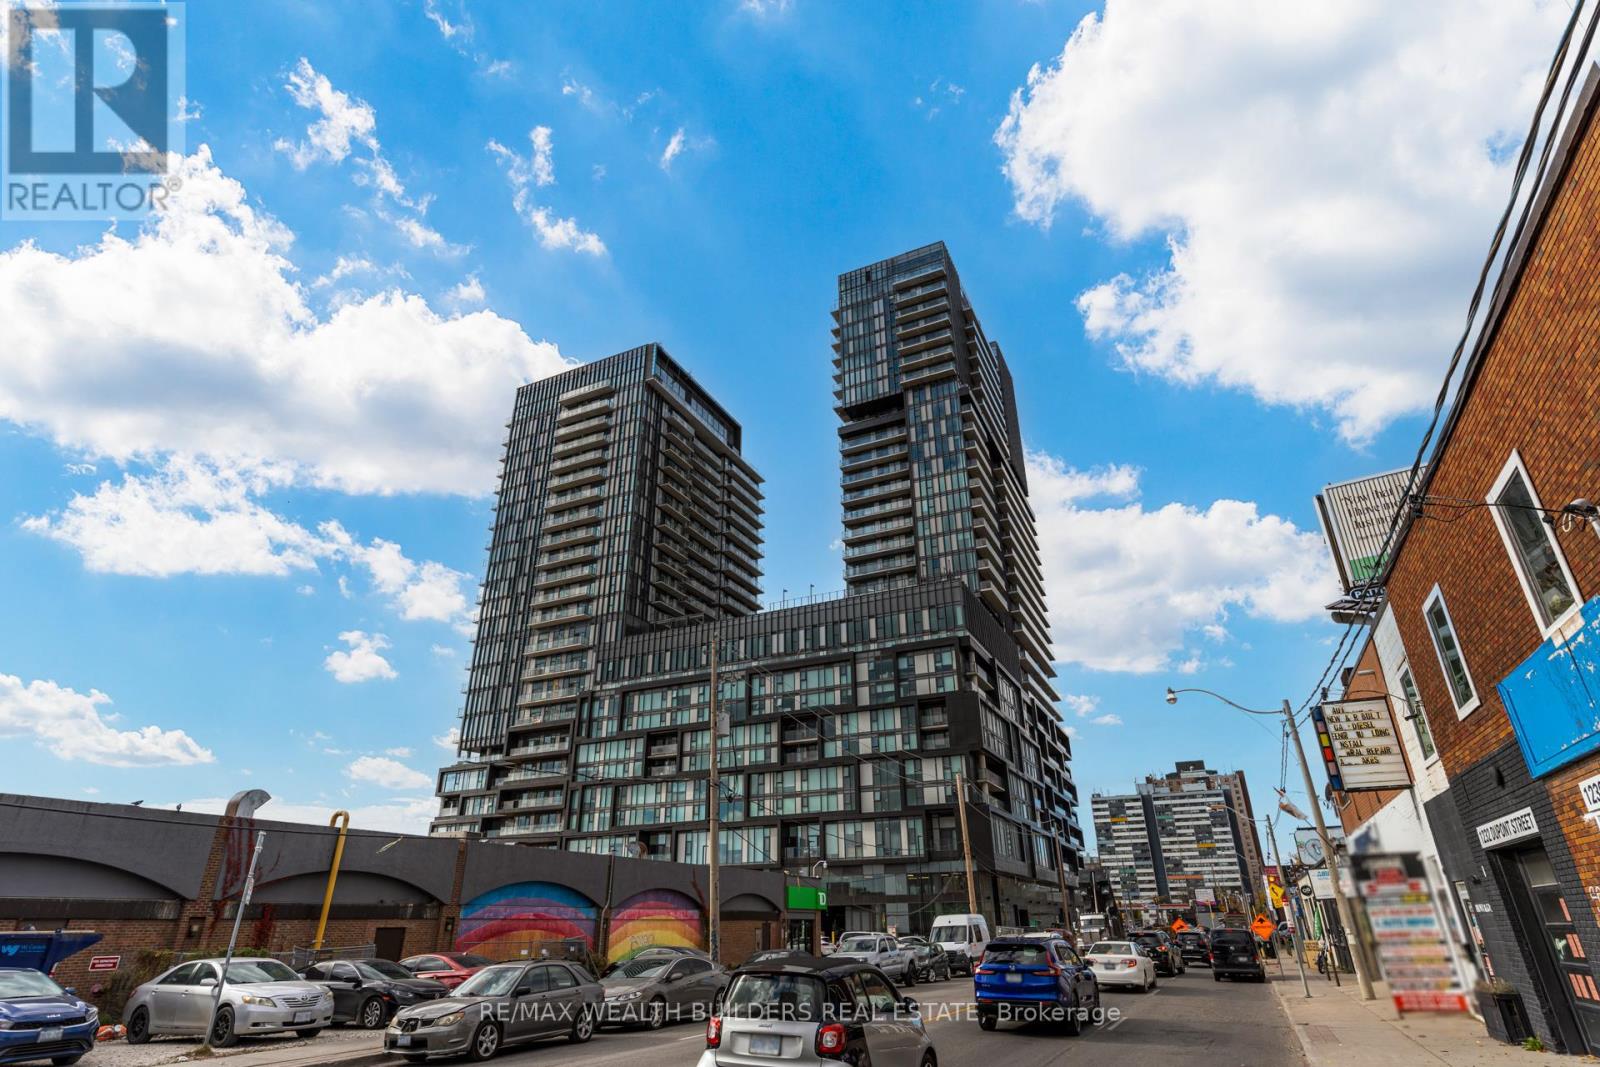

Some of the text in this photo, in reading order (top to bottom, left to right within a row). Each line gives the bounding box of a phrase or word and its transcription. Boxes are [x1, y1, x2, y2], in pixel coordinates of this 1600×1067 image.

[1584, 781, 1600, 805] 123
[1490, 820, 1512, 841] DUPONT
[1510, 812, 1534, 834] STREET
